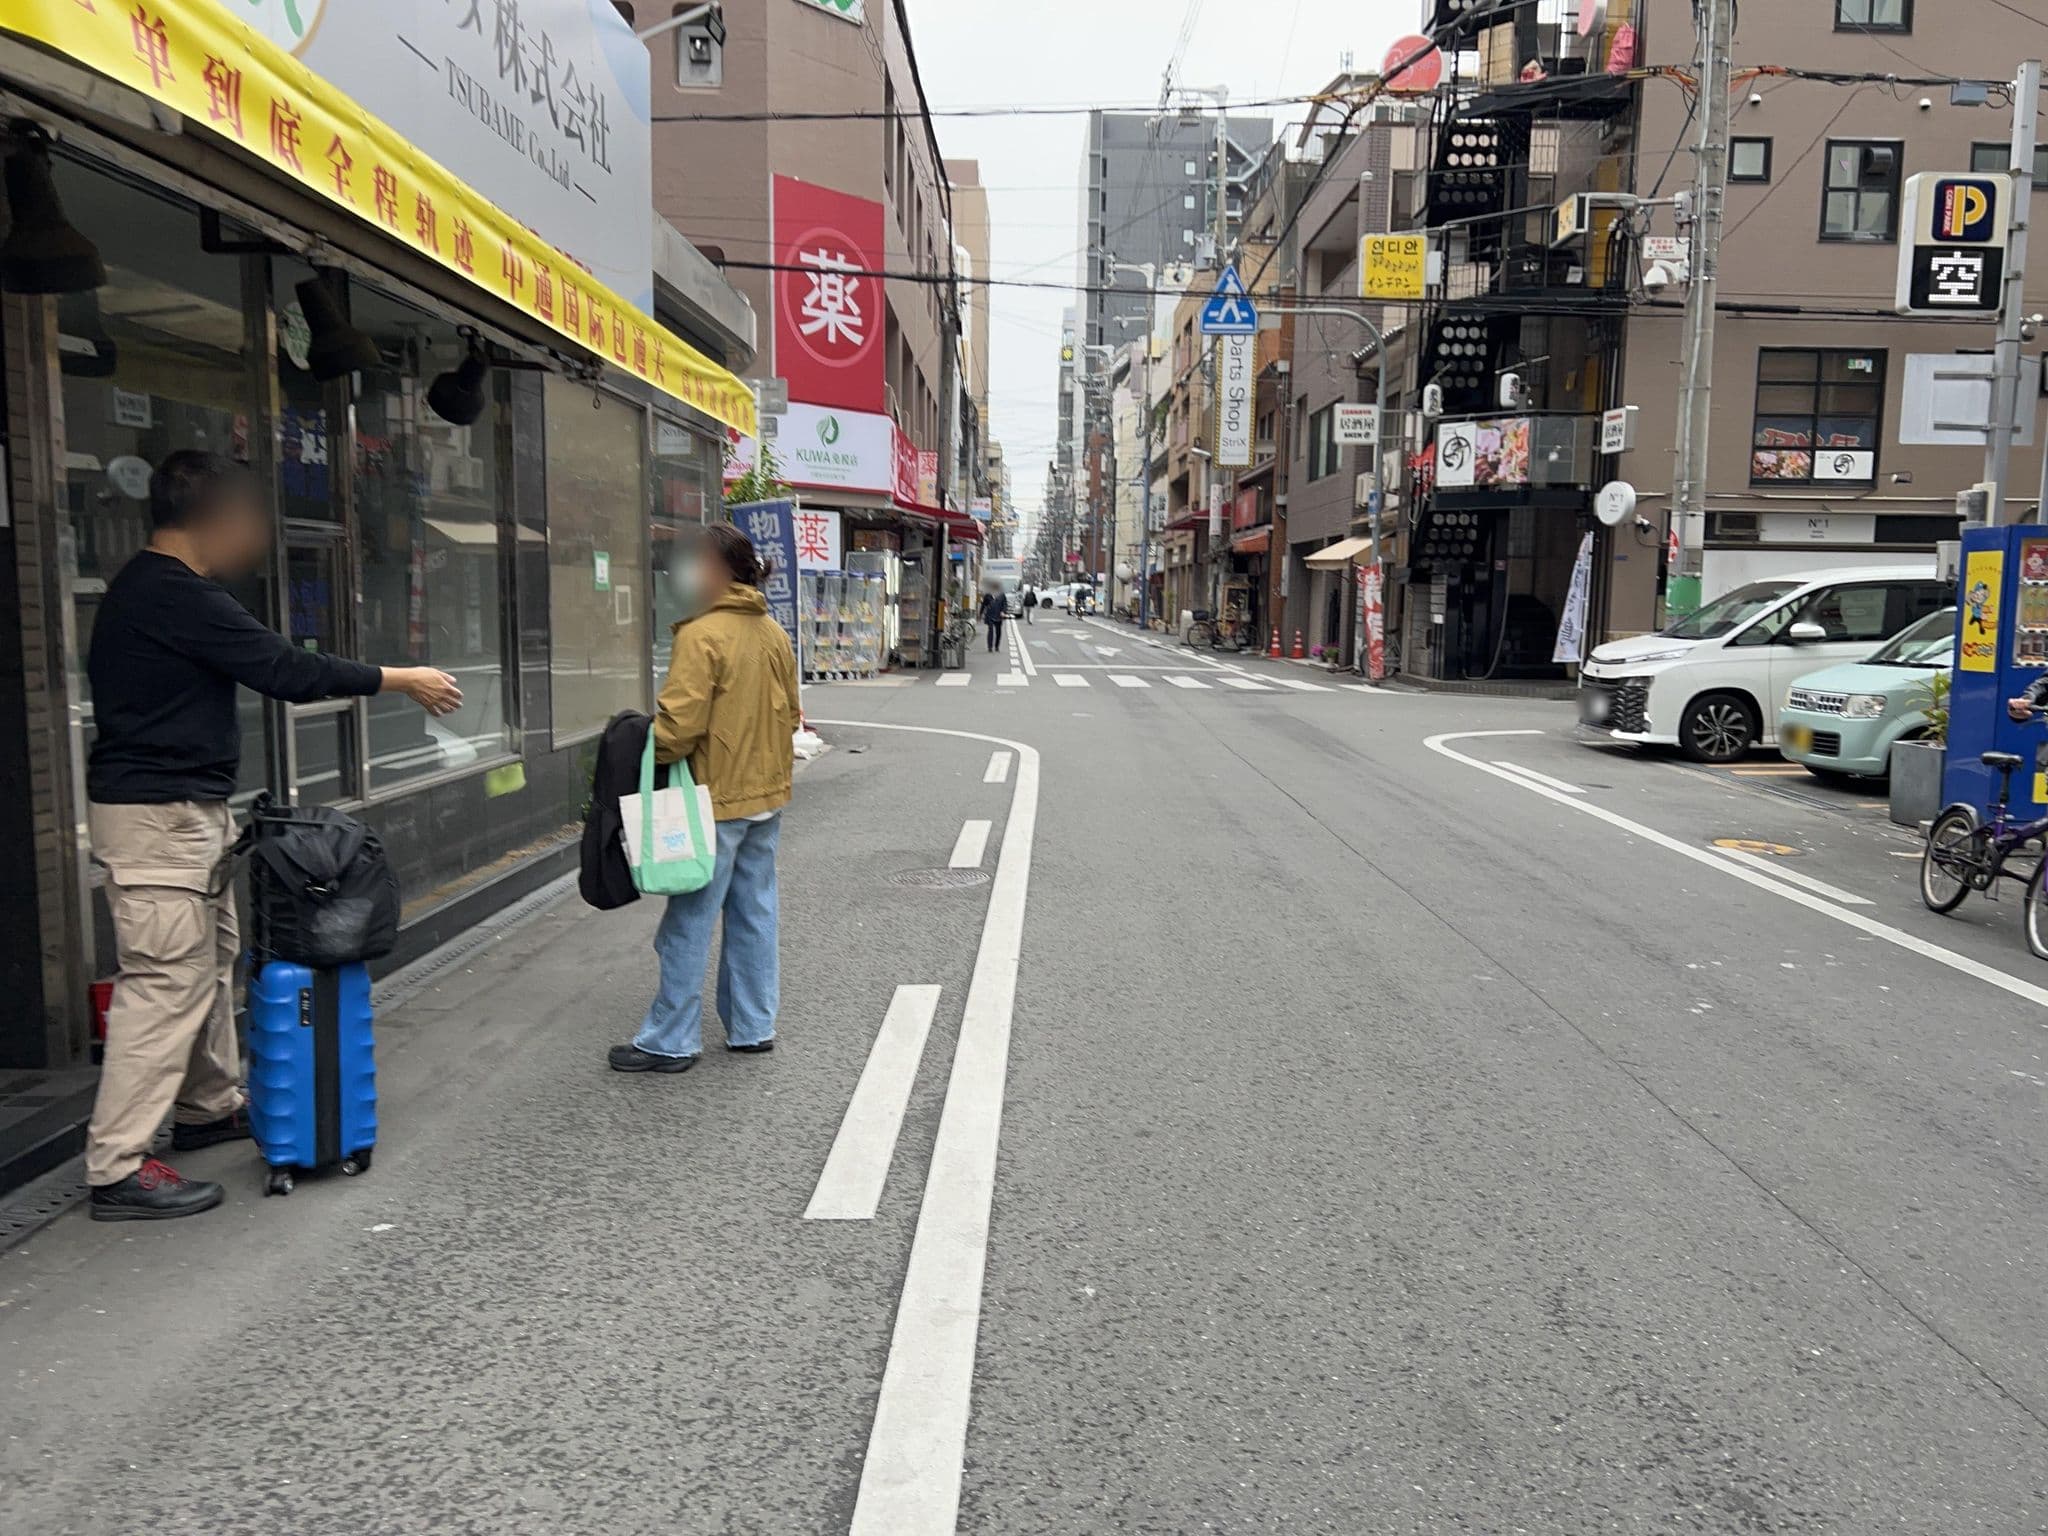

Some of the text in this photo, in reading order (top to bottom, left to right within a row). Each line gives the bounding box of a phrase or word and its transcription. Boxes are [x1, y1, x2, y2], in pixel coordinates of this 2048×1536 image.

[445, 55, 526, 156] TSUBAME
[800, 247, 865, 347] 薬
[1928, 250, 1982, 303] 空
[1225, 386, 1246, 431] Shop
[795, 447, 830, 465] KUWA
[793, 513, 829, 563] 薬
